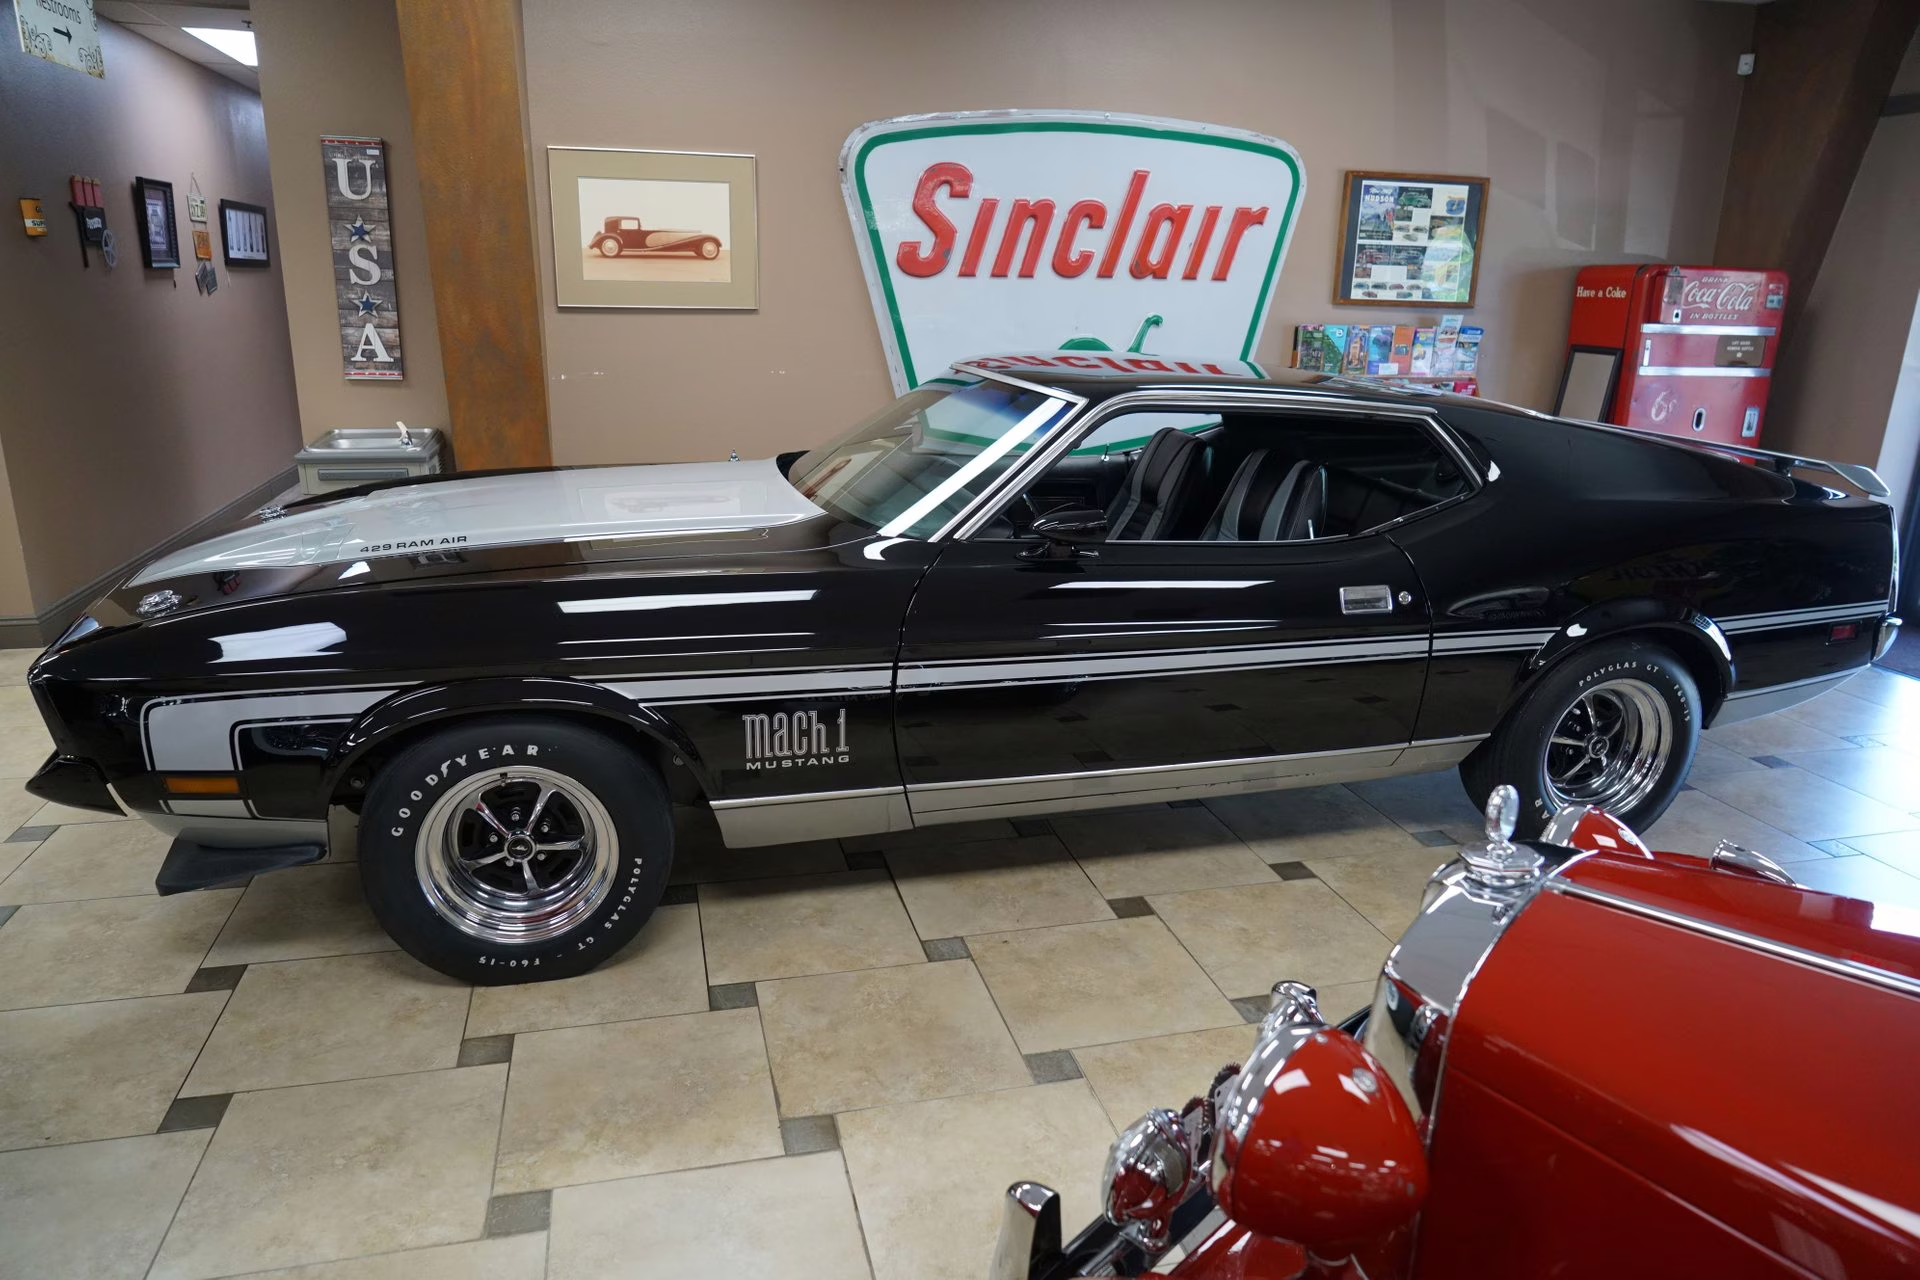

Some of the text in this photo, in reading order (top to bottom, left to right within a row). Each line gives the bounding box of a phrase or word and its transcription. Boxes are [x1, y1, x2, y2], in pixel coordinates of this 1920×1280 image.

[1365, 195, 1395, 203] HUDSON
[896, 161, 1270, 282] Sinclair
[1576, 286, 1627, 299] Have a Coke
[1683, 280, 1758, 311] Coca-Cola
[1689, 312, 1740, 321] IN BOTTLES
[360, 535, 467, 553] 429 RAM AIR
[1578, 661, 1637, 687] POLYGLAS
[1646, 664, 1659, 673] GT
[836, 708, 849, 752] 1
[746, 755, 850, 770] MUSTANG
[391, 744, 539, 837] GOODYEAR
[478, 857, 643, 967] POLYGLAS GT F60-15
